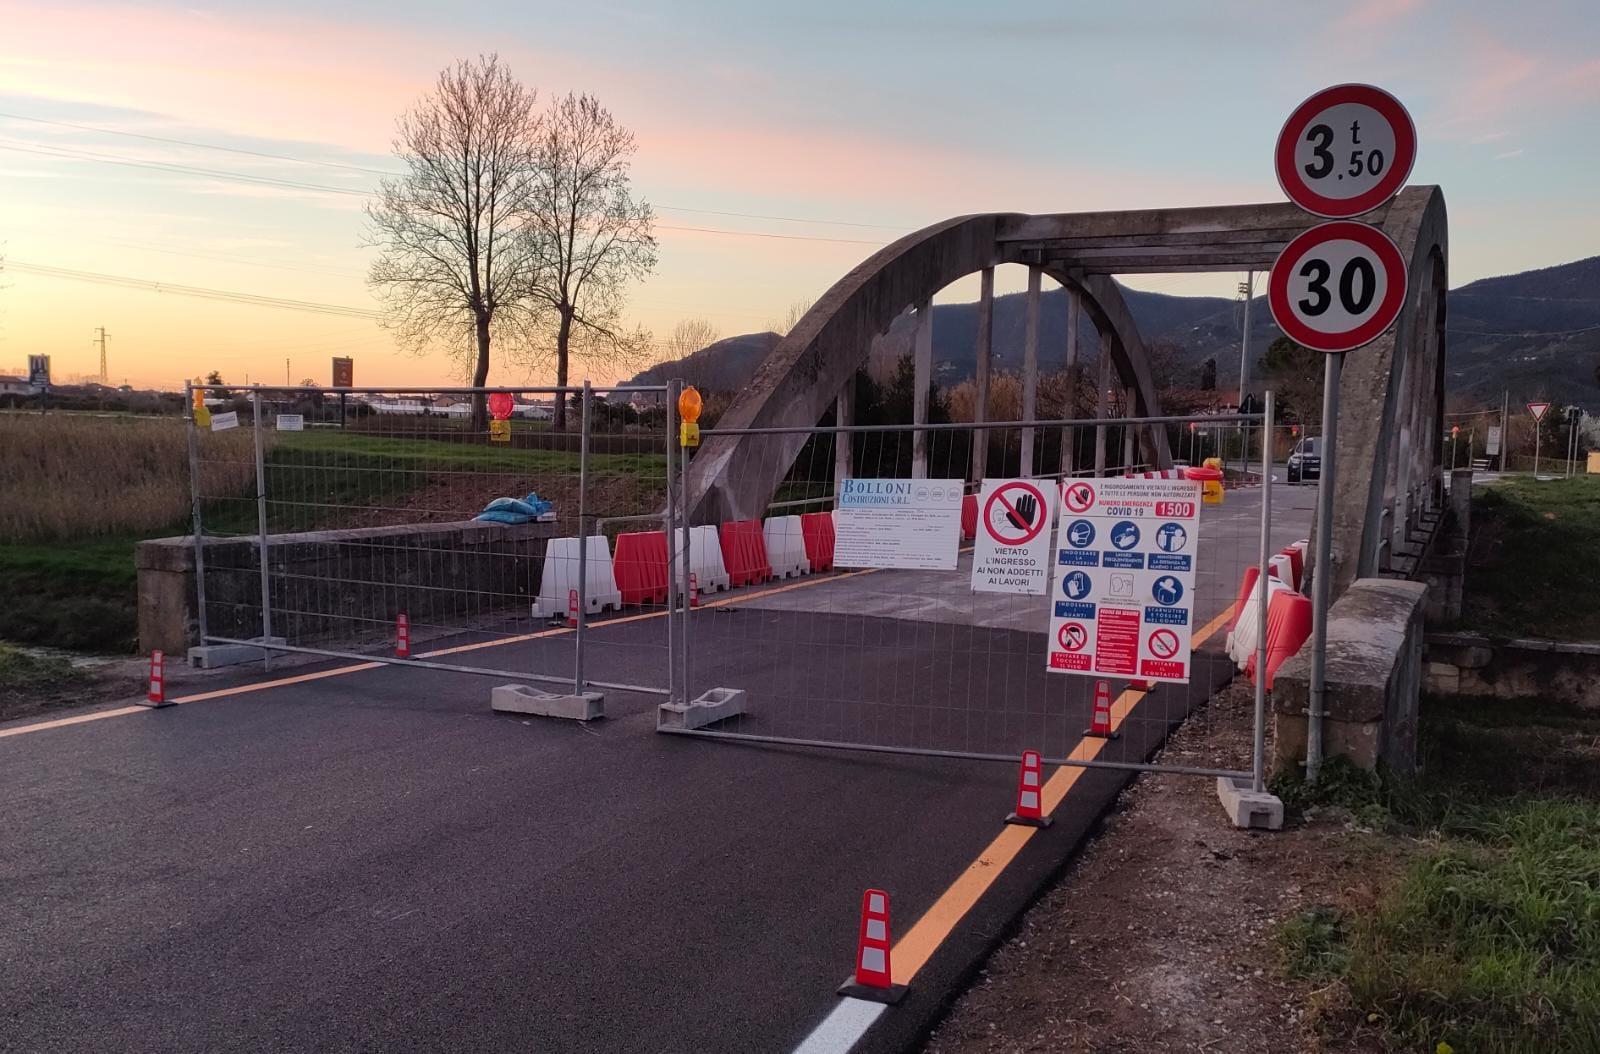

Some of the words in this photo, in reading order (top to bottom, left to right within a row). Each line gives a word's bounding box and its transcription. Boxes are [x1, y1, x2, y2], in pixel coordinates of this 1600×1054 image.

[1350, 119, 1361, 145] t
[1298, 256, 1376, 317] 30
[843, 479, 912, 495] BOLLONI
[1106, 507, 1132, 516] COVID
[1135, 508, 1144, 516] 19
[1160, 502, 1190, 516] 1500
[994, 547, 1029, 556] VIETATO
[985, 557, 1036, 567] L'INGRESSO
[976, 567, 985, 575] AI
[987, 567, 1005, 575] NON
[1007, 568, 1044, 577] ADDETTI
[988, 577, 997, 585] AI
[999, 578, 1030, 587] LAVORI
